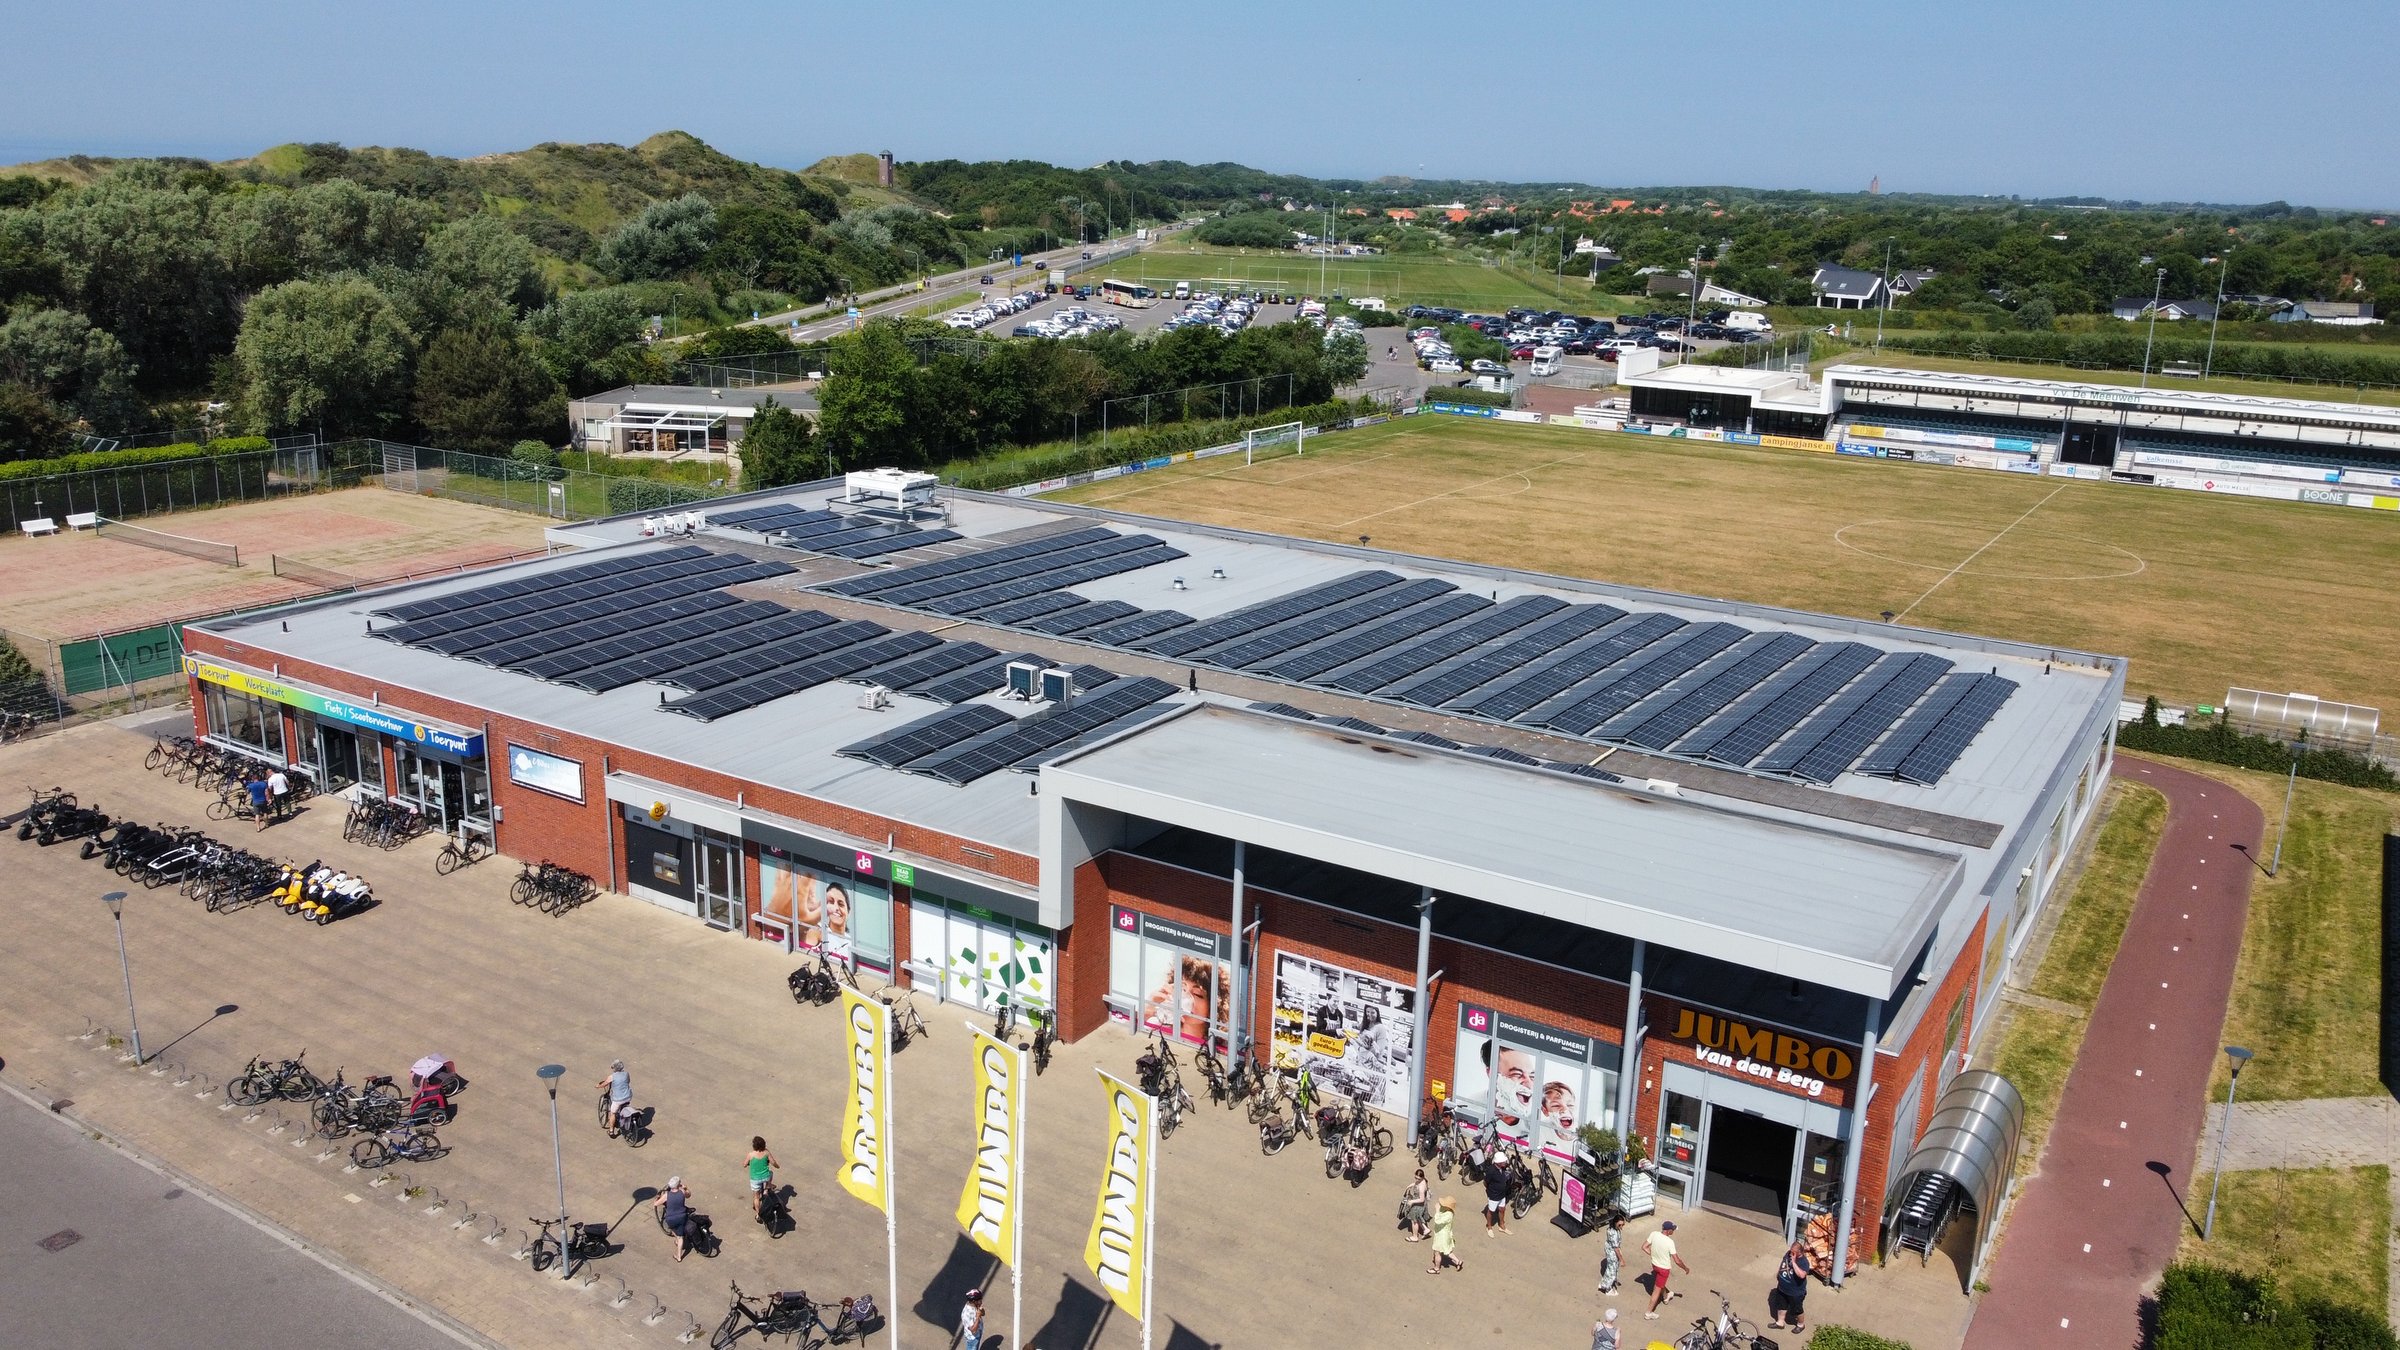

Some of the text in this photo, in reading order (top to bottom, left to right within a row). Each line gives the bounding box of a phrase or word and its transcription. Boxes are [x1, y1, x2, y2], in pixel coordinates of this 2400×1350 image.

[2073, 390, 2086, 398] De
[2090, 391, 2141, 402] Meeuwen
[1761, 437, 1835, 451] campingjanse.nl
[2303, 490, 2344, 502] BOONE
[136, 641, 172, 665] DE
[199, 663, 230, 683] Toerpunt
[244, 677, 286, 699] Werkplaats
[324, 700, 343, 716] Fiets
[348, 707, 404, 733] Scooterverhuur
[428, 729, 468, 752] Toerpunt
[856, 854, 872, 870] da
[1119, 913, 1134, 927] da
[1145, 921, 1177, 937] DROGISTERIJ
[1182, 932, 1215, 946] PARFUMERIE
[1468, 1012, 1486, 1027] da
[1312, 1041, 1342, 1054] goedkoper
[1499, 1021, 1540, 1039] DROGISTERIJ
[1545, 1034, 1586, 1052] PARFUMERIE
[1670, 1008, 1853, 1080] JUMBO
[1695, 1044, 1825, 1097] Van den Berg
[969, 1044, 1010, 1244] JUMBO
[1665, 1136, 1695, 1151] JUMBO
[1096, 1089, 1140, 1294] JUMBO
